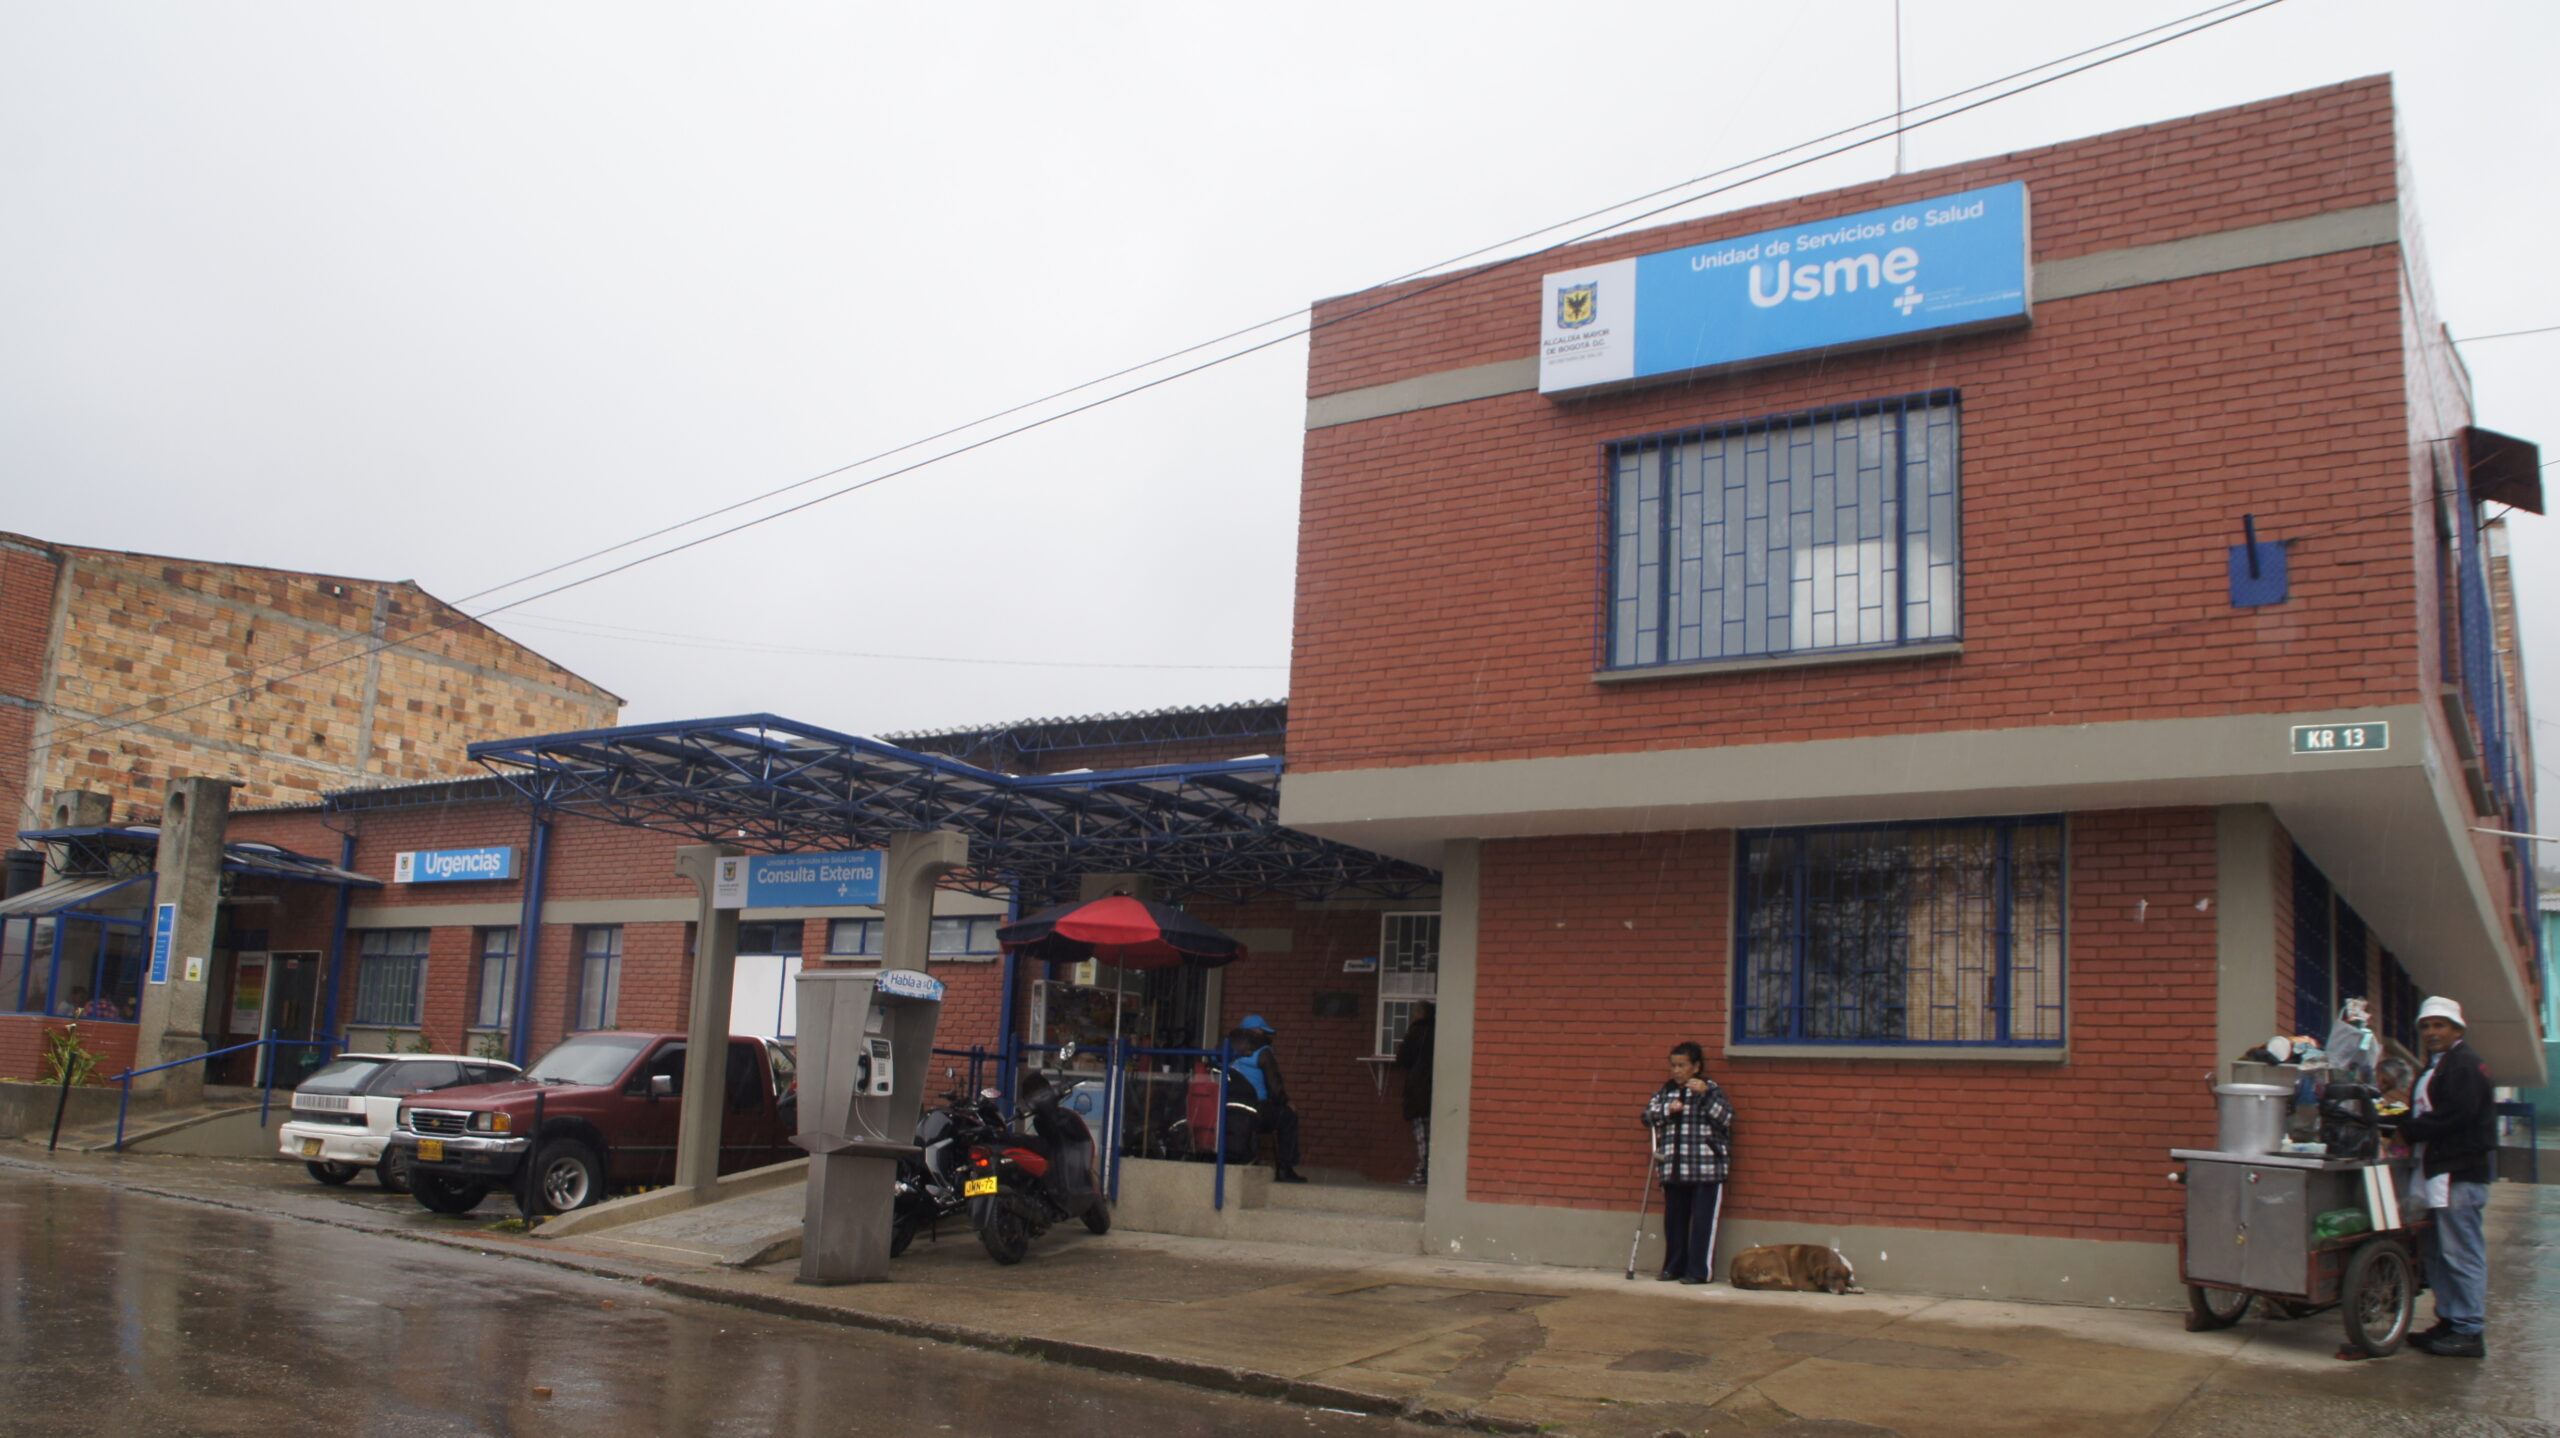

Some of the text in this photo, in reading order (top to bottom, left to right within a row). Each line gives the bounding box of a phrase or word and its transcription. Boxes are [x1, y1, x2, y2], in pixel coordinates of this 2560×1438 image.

[1691, 199, 1984, 272] Unidad de Servicios de Salud
[1748, 246, 1920, 308] Usme
[2307, 728, 2366, 749] KR 13
[426, 848, 502, 878] Urgencias
[757, 864, 874, 884] Consulta Externa
[891, 973, 915, 988] Habla
